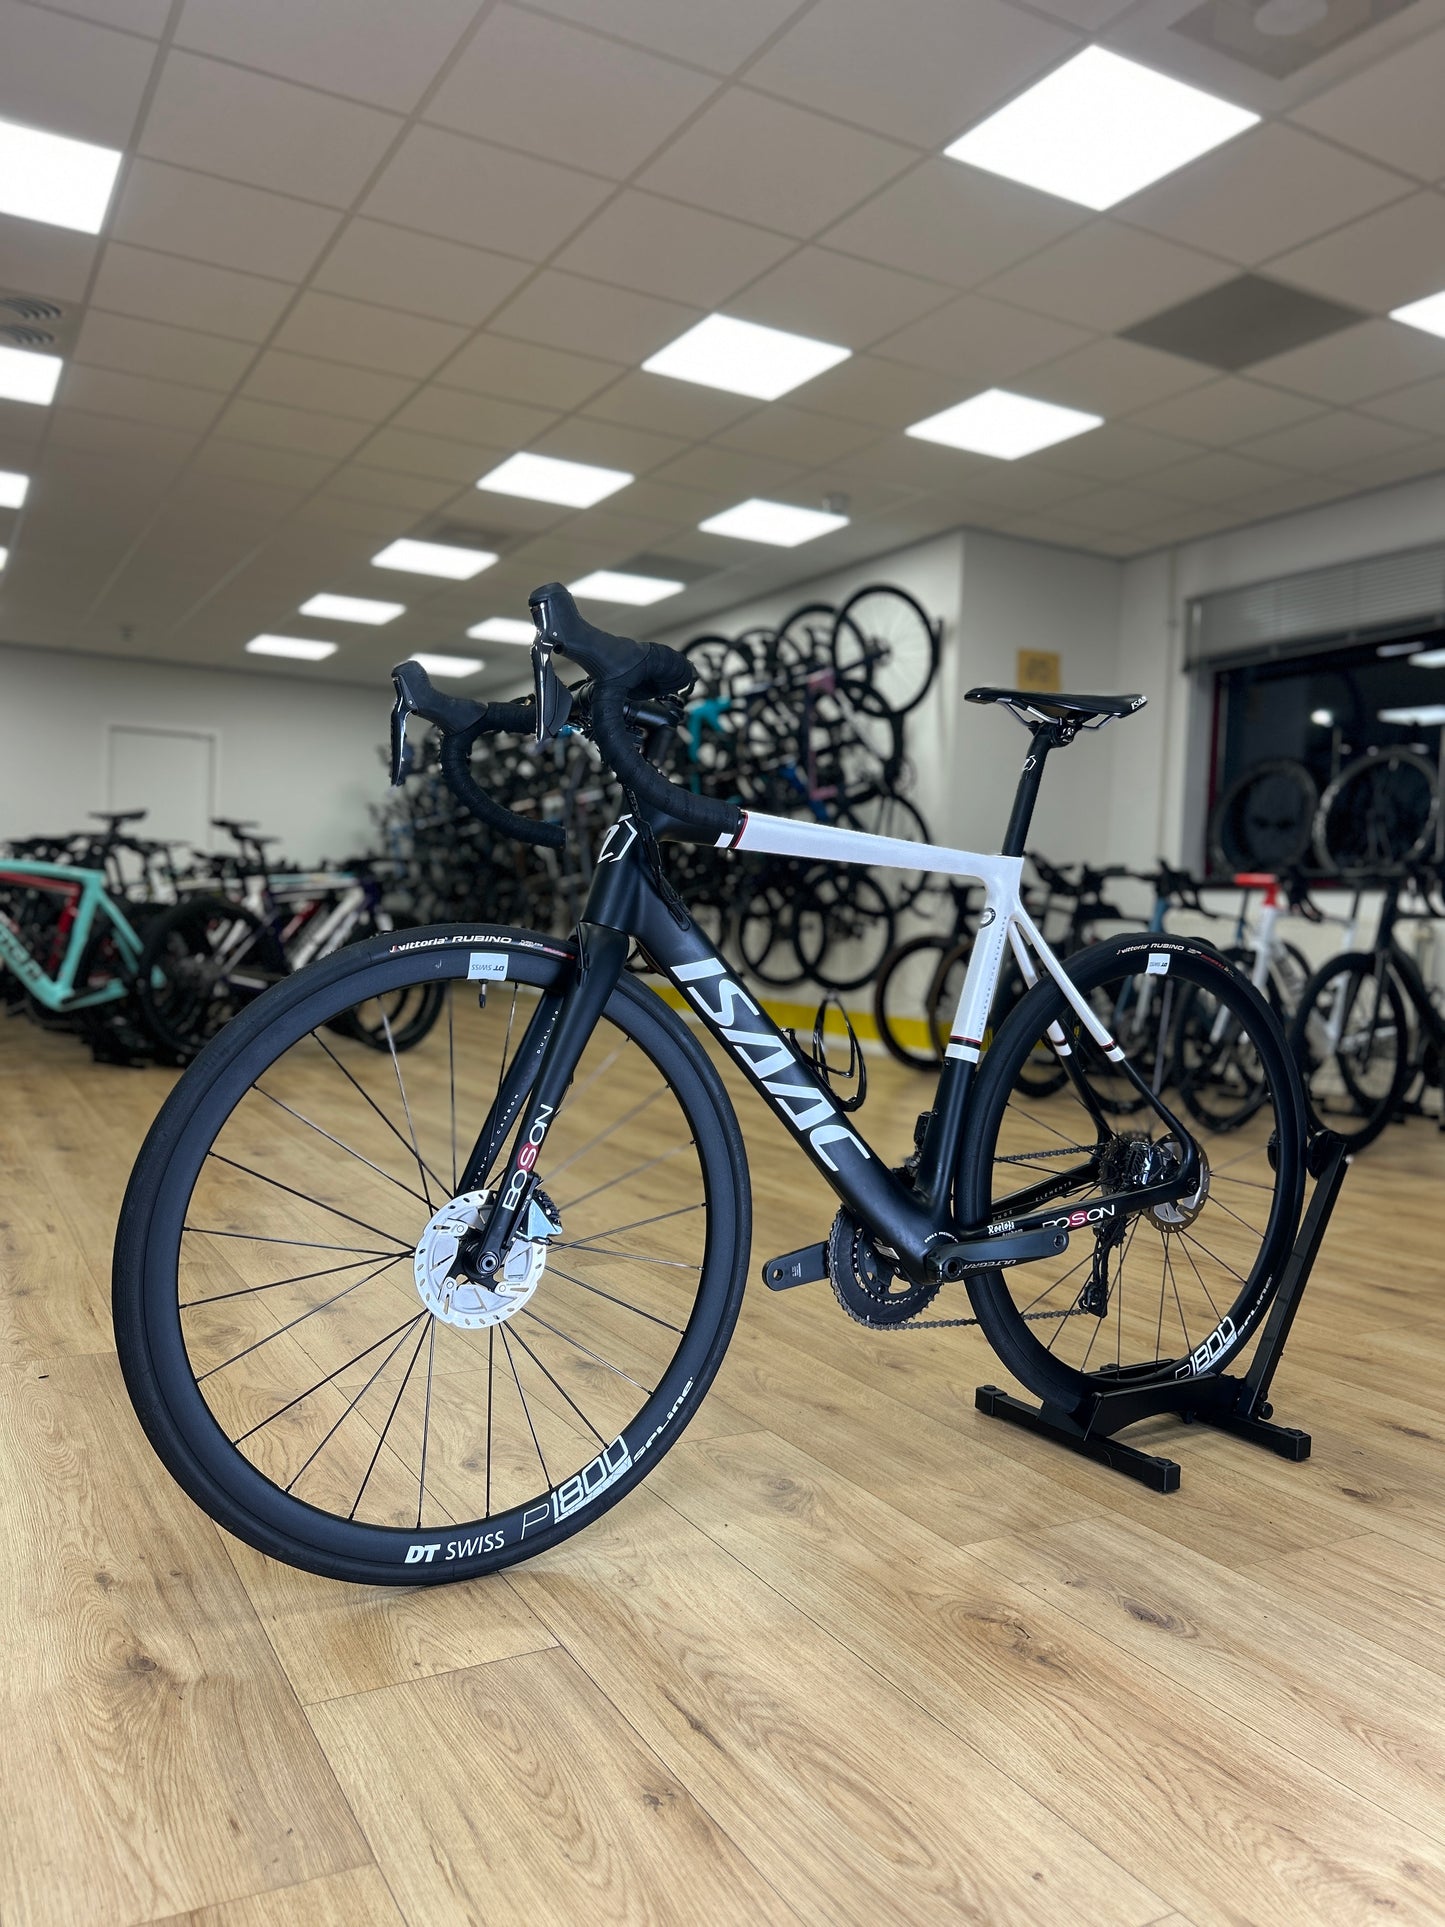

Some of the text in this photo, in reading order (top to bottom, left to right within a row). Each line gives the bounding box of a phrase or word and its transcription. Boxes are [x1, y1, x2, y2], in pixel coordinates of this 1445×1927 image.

[398, 937, 447, 951] vittoria
[452, 935, 512, 944] RUBINO
[670, 957, 870, 1171] ISAAC
[502, 1104, 554, 1211] BOSON
[963, 1259, 1017, 1270] ULTEGRA
[404, 1544, 441, 1563] DT
[445, 1530, 505, 1560] SWISS
